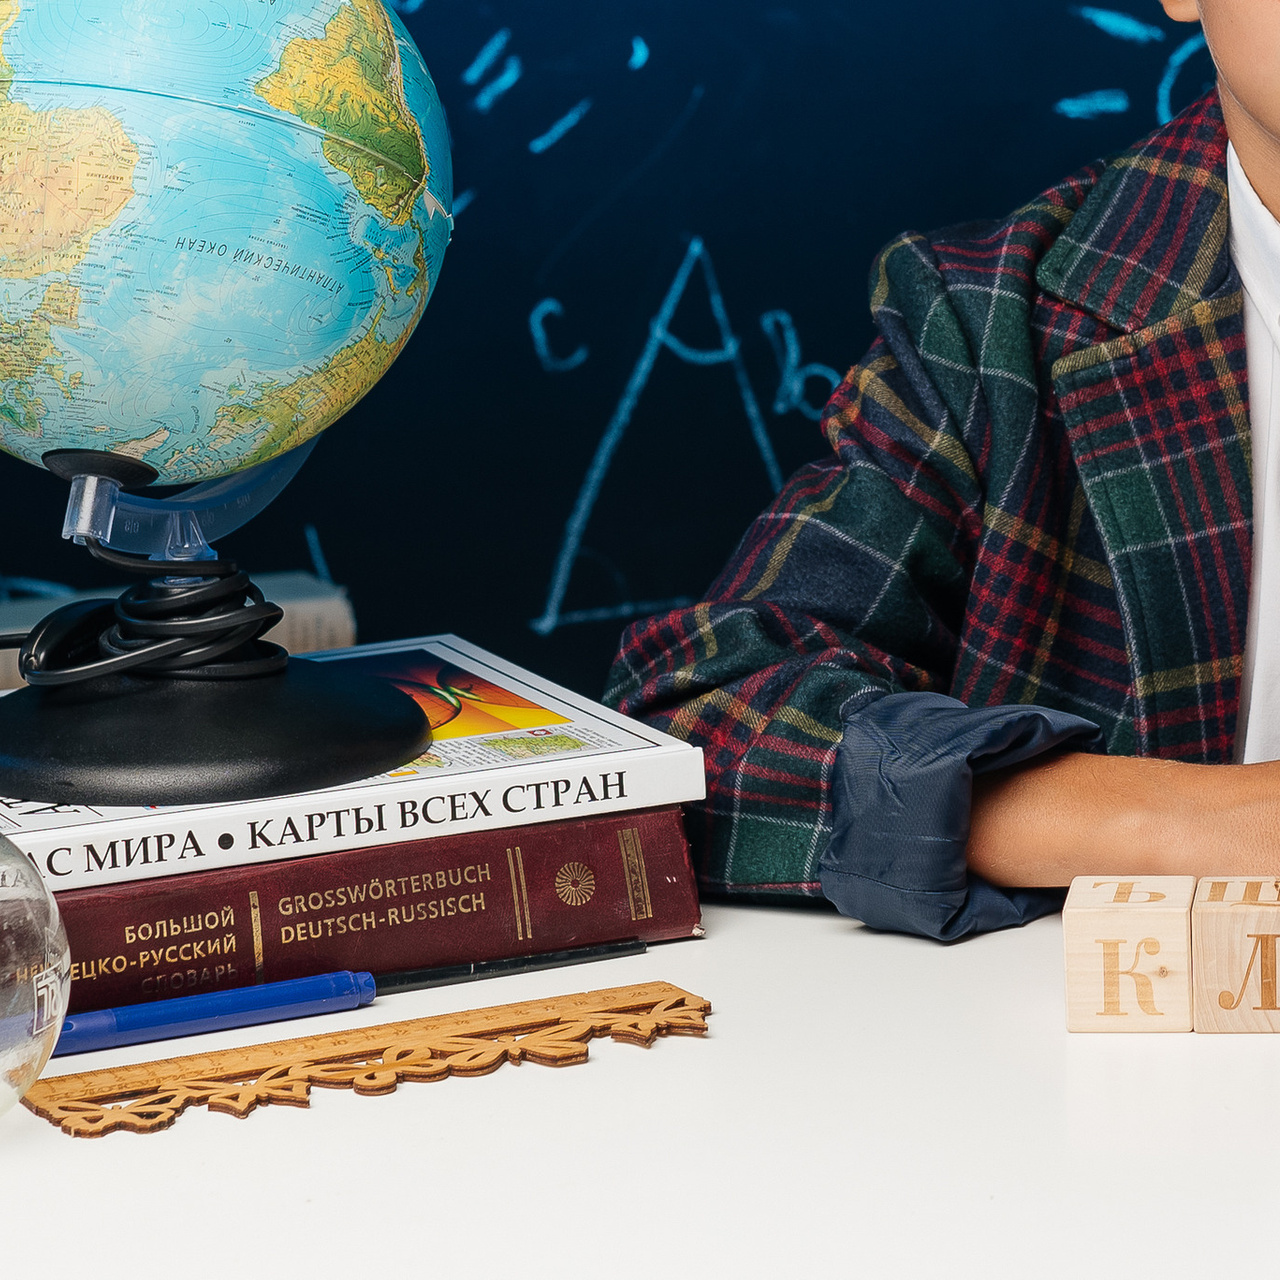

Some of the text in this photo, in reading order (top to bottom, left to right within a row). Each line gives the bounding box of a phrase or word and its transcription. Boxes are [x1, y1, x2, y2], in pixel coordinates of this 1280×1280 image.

[174, 236, 345, 294] АТЛАНТИЧЕСКИЙ ОКЕАН
[83, 829, 206, 873] МИРА
[247, 803, 387, 850] КАРТЫ
[398, 789, 494, 829] ВСЕХ
[501, 771, 628, 814] СТРАН
[277, 862, 492, 917] GROSSWÖRTERBUCH
[124, 905, 236, 944] БОЛЬШОЙ
[280, 892, 486, 945] DEUTSCH-RUSSISCH
